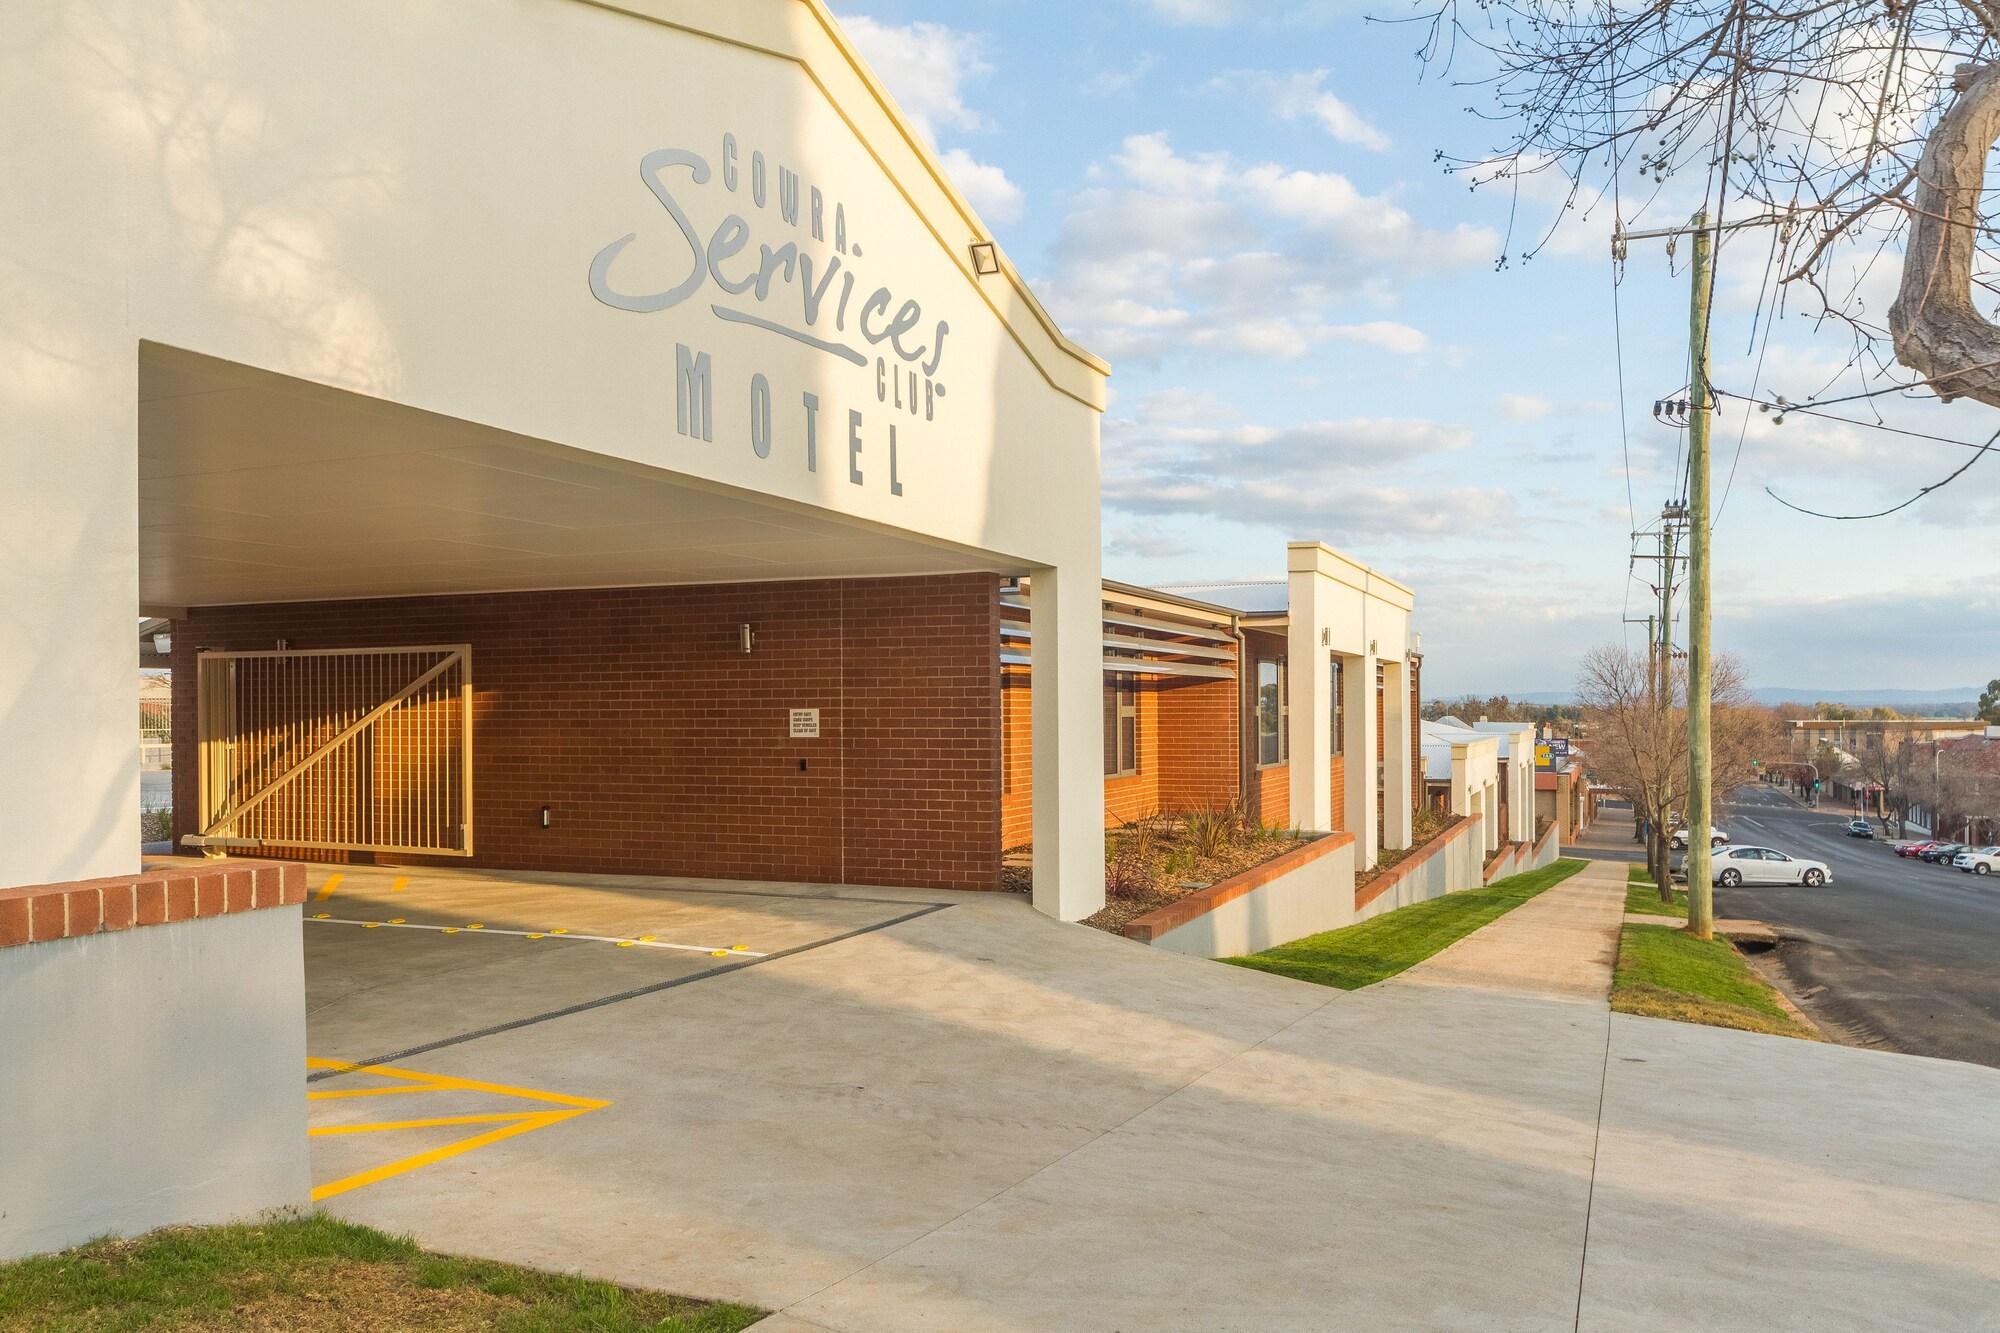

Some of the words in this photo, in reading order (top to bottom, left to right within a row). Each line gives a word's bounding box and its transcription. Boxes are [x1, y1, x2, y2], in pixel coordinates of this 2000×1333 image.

[588, 148, 949, 376] Services
[723, 132, 846, 255] COWRA
[675, 342, 903, 497] MOTEL
[877, 356, 934, 421] CLUB
